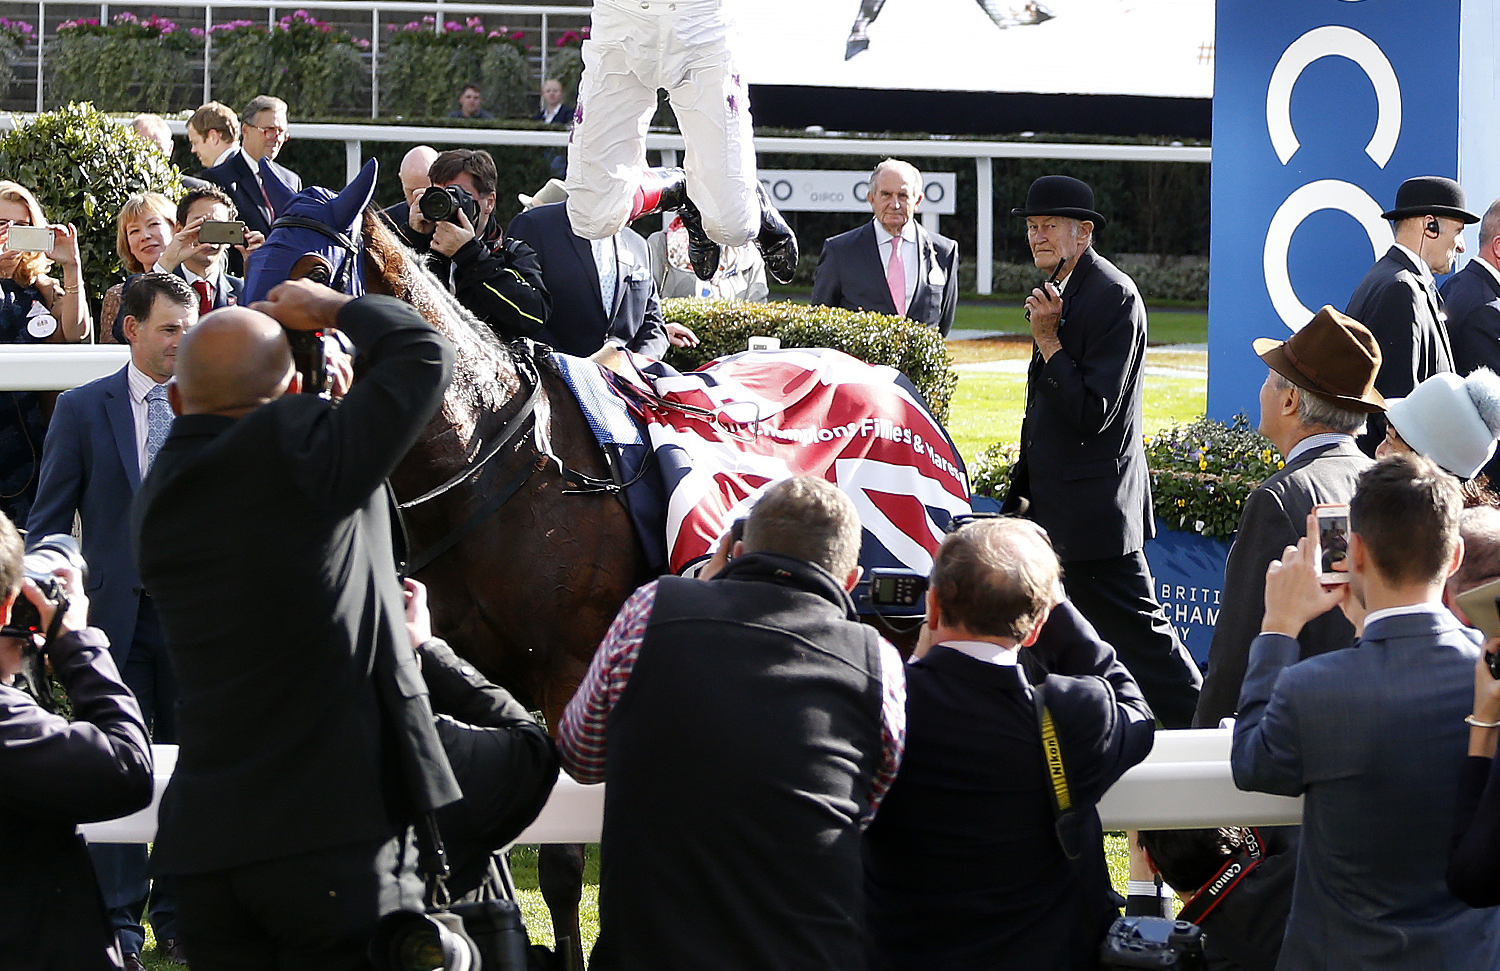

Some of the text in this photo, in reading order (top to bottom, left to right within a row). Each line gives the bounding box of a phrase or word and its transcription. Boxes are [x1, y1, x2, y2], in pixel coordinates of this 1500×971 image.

[912, 434, 926, 455] &
[1161, 583, 1221, 605] BRITI
[1162, 602, 1221, 627] CHAM
[1049, 740, 1063, 777] Nikon
[1209, 863, 1242, 896] Canon
